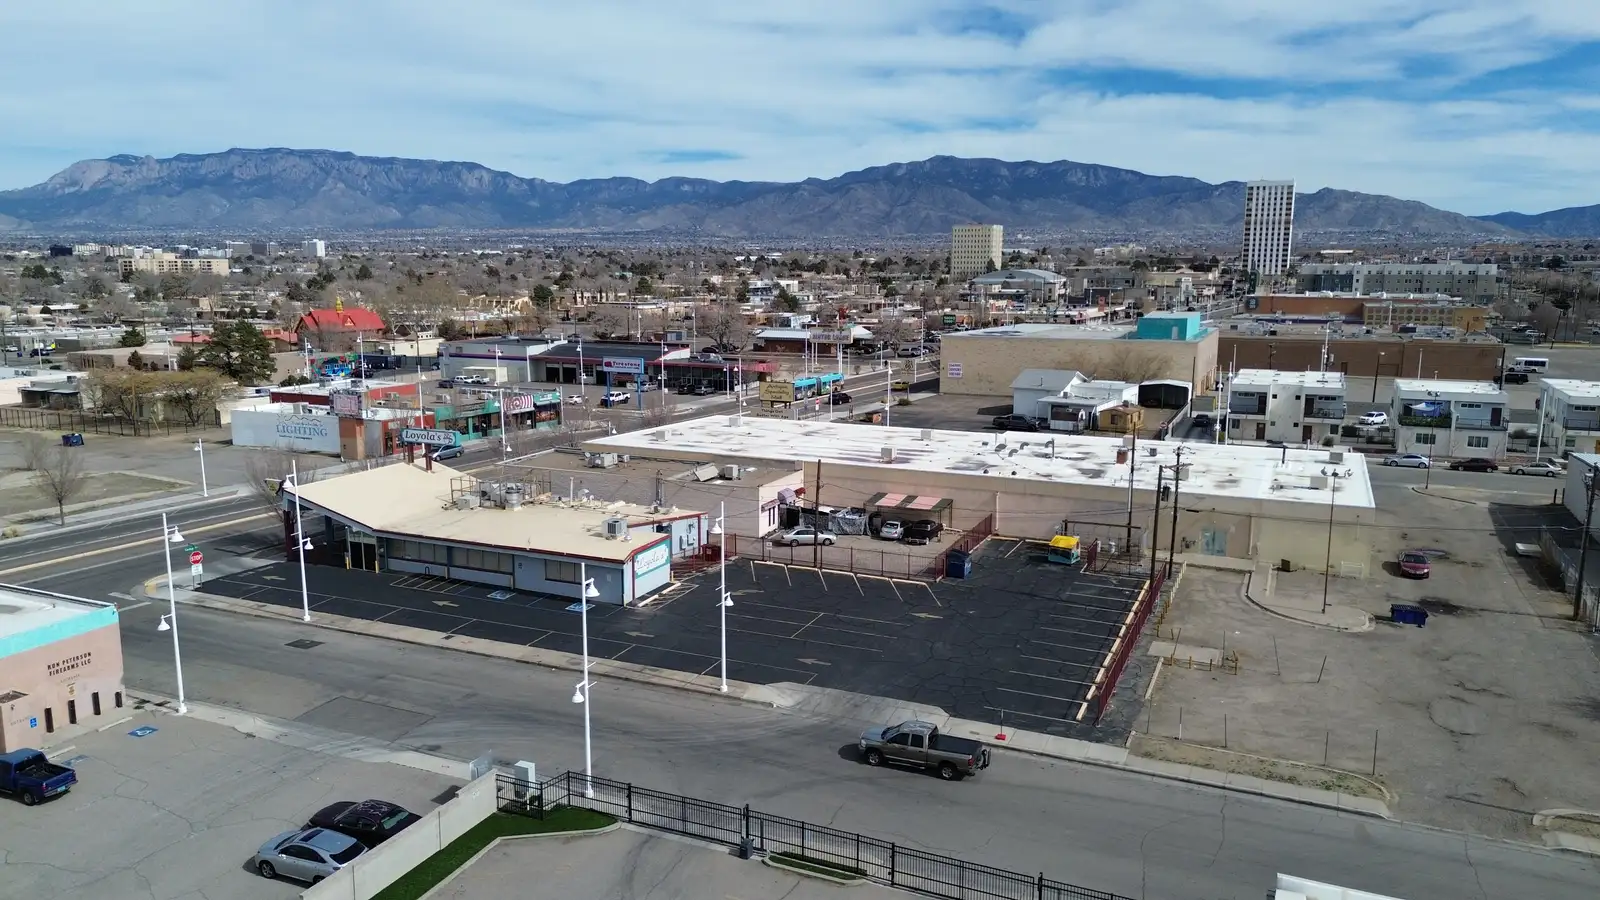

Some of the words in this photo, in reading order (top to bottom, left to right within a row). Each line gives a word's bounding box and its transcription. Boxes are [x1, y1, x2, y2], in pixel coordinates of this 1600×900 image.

[276, 424, 328, 437] LIGHTING
[404, 430, 442, 442] Loyola's
[190, 554, 203, 562] STOP
[47, 661, 60, 671] RON
[61, 651, 92, 666] PETERSON
[49, 663, 79, 677] FIREARMS
[80, 658, 91, 667] LLC
